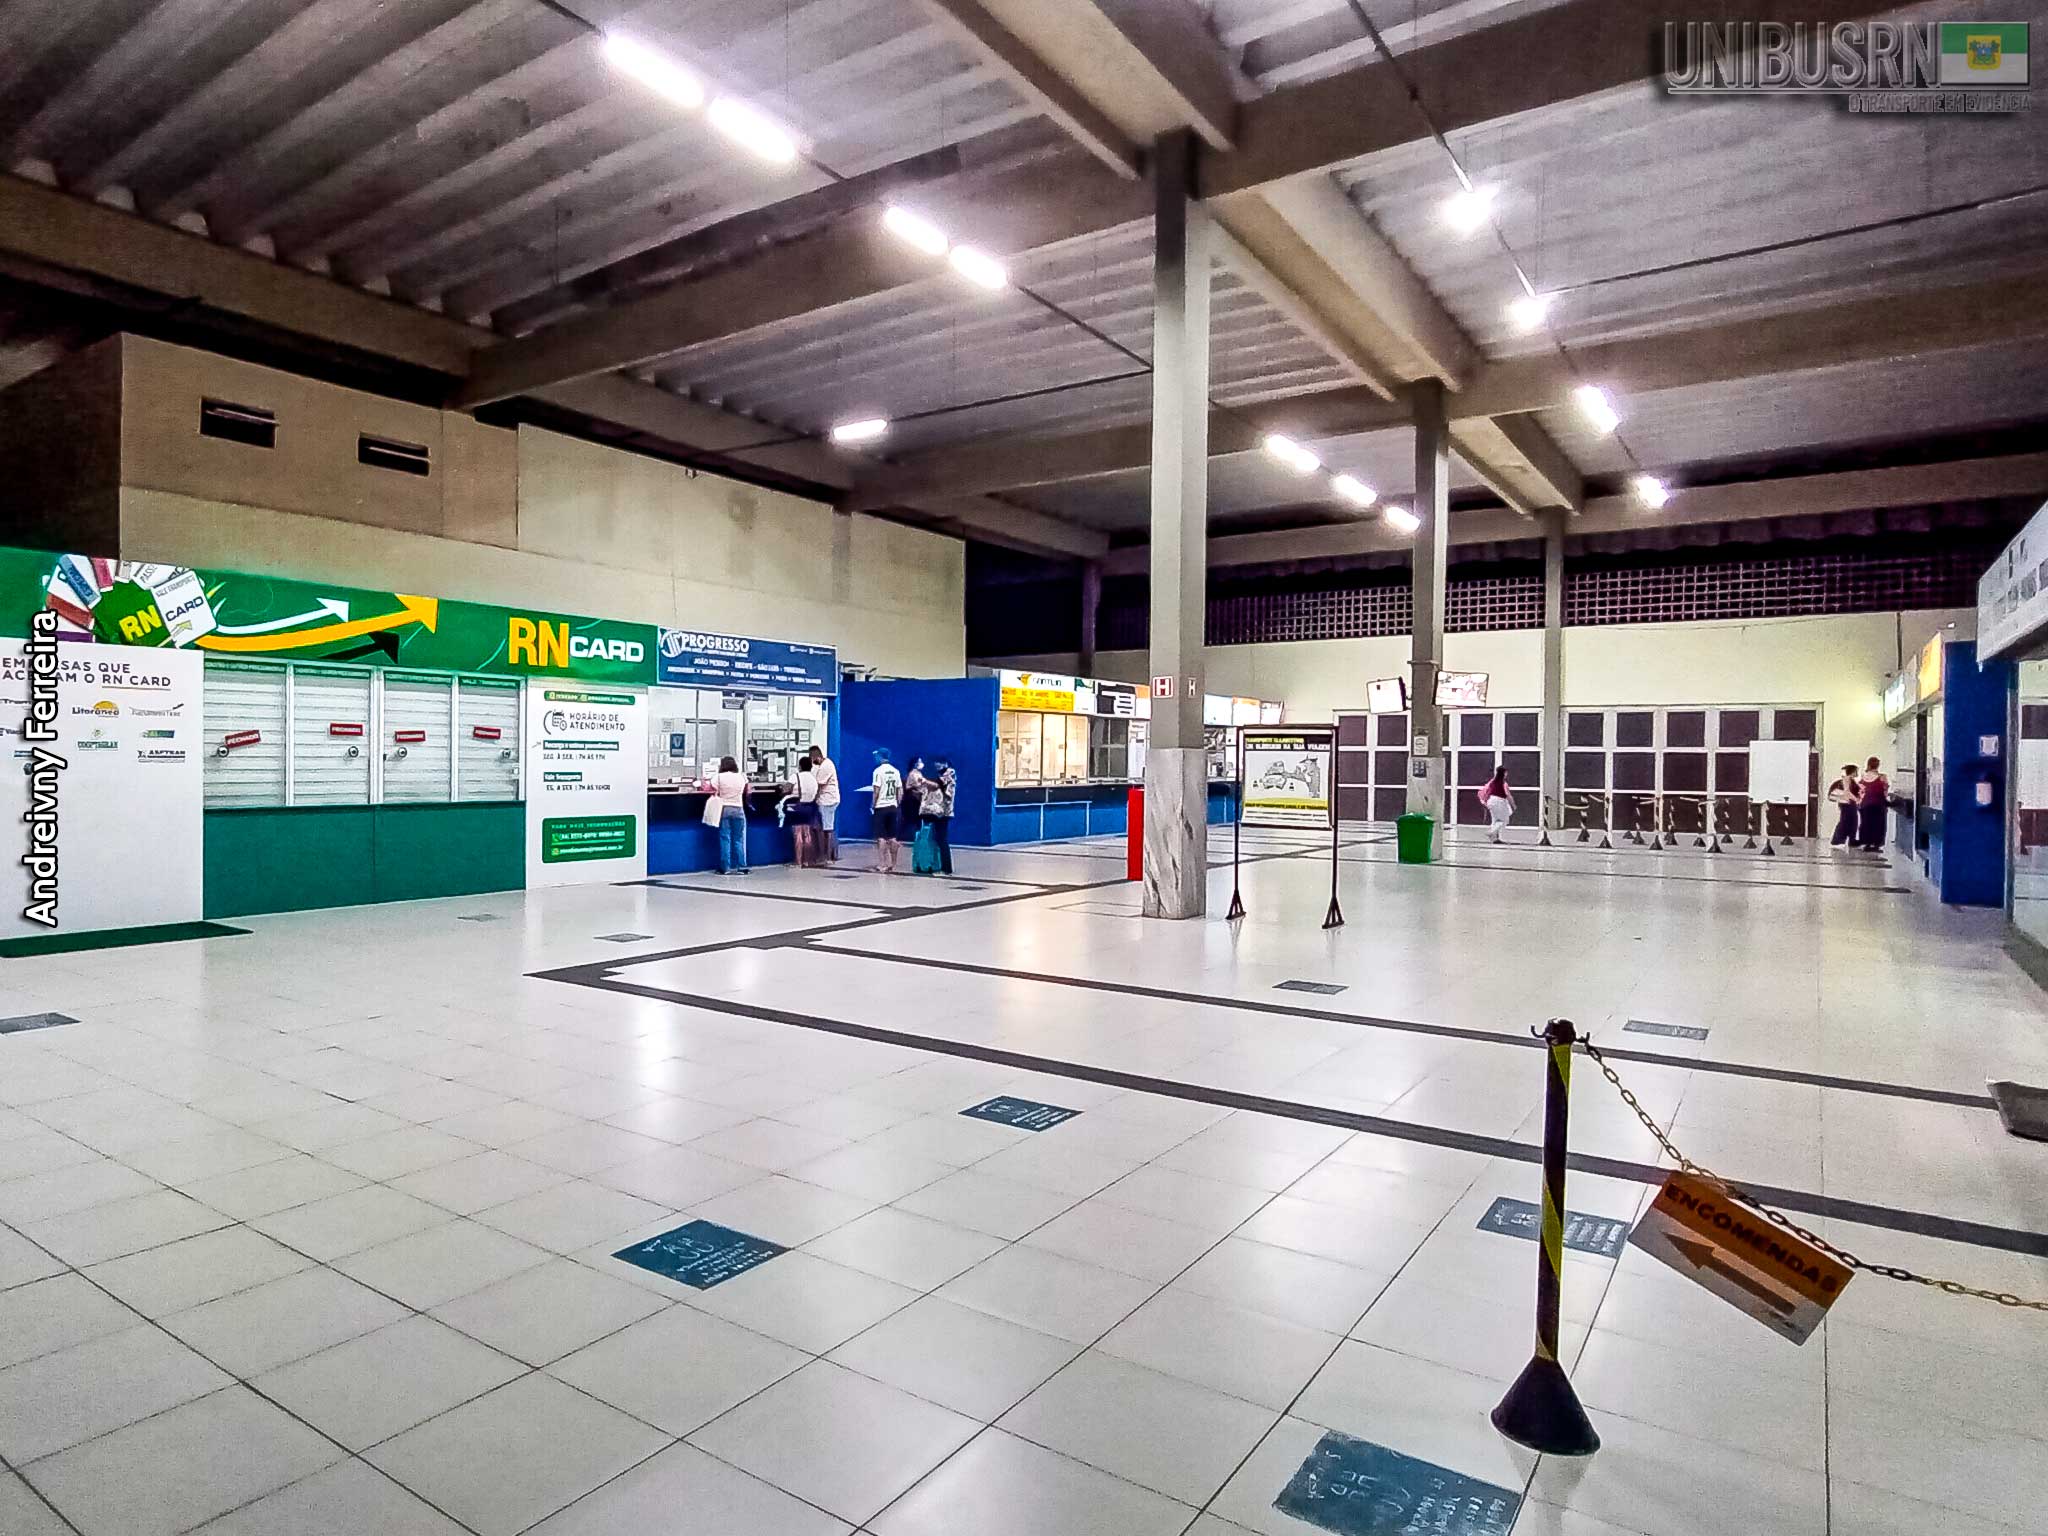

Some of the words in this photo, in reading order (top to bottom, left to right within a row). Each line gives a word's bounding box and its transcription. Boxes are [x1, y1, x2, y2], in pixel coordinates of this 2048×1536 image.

[119, 604, 162, 642] RN
[165, 596, 204, 622] CARD
[508, 617, 569, 668] RN
[570, 636, 645, 663] CARD
[682, 632, 750, 653] PROGRESSO
[98, 662, 131, 674] QUE
[84, 673, 95, 684] O
[102, 674, 123, 685] RN
[130, 676, 171, 687] CARD
[570, 711, 606, 721] HORÁRIO
[609, 714, 619, 722] DE
[570, 722, 625, 731] ATENDIMENTO
[1665, 1184, 1838, 1293] ENCOMENDAS
